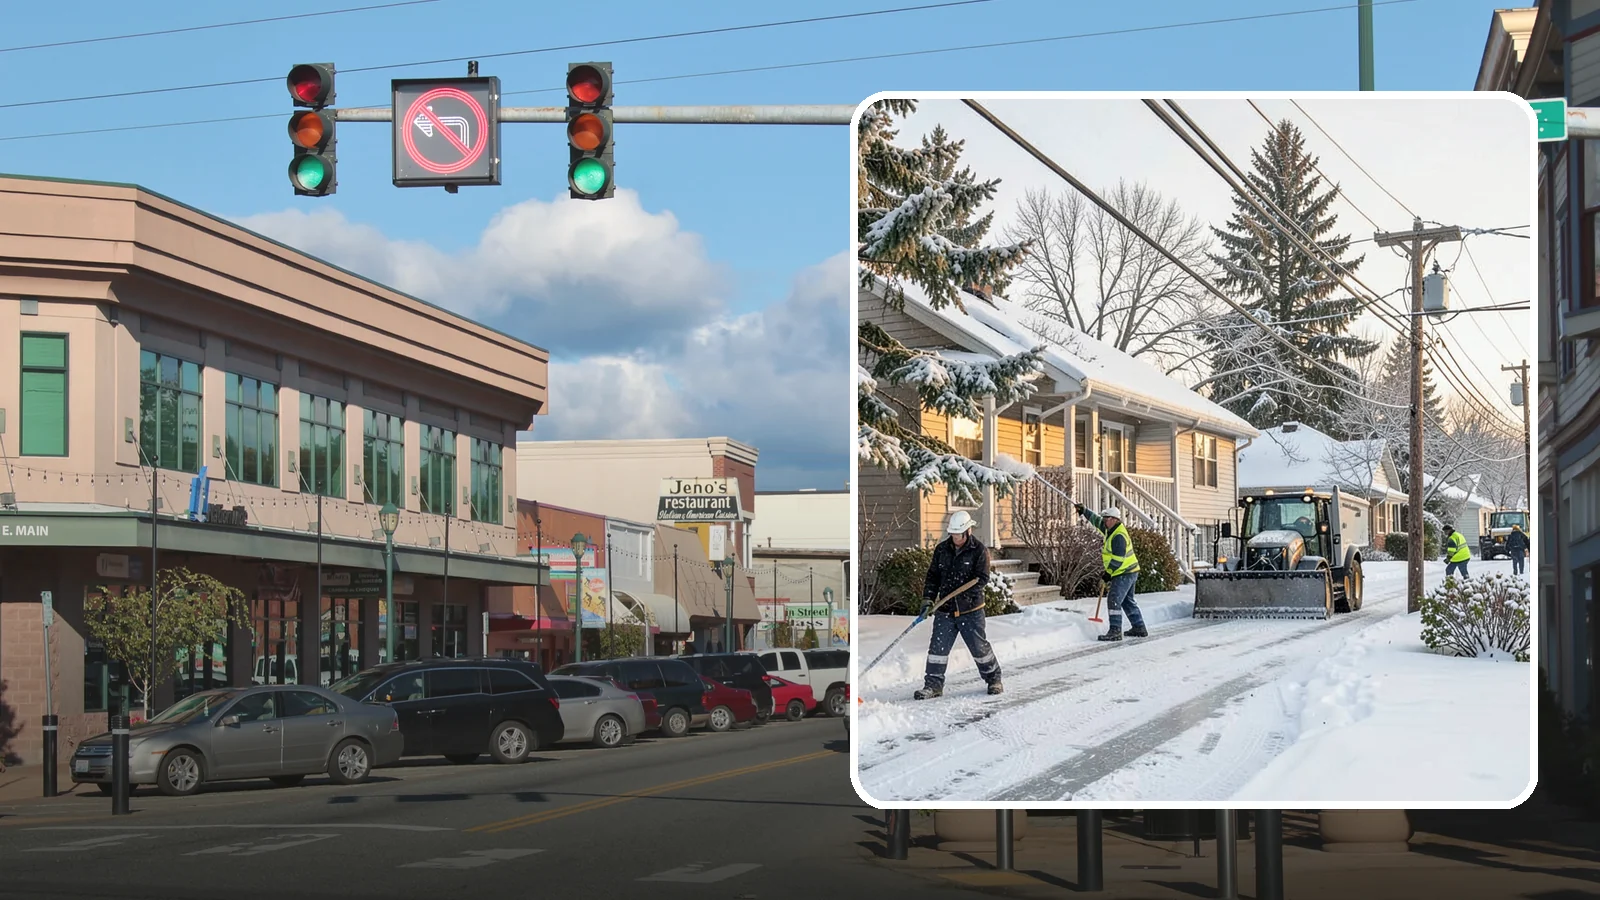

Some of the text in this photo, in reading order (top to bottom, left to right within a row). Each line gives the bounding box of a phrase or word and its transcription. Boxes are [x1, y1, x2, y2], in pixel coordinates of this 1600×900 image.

[670, 480, 727, 494] Jeno's
[665, 496, 731, 509] restaurant
[659, 510, 681, 519] Italian
[686, 510, 714, 519] American
[715, 510, 737, 519] Cuisine
[2, 525, 49, 536] E. MAIN
[785, 607, 795, 617] in
[797, 607, 828, 616] Street
[789, 619, 824, 627] lass
